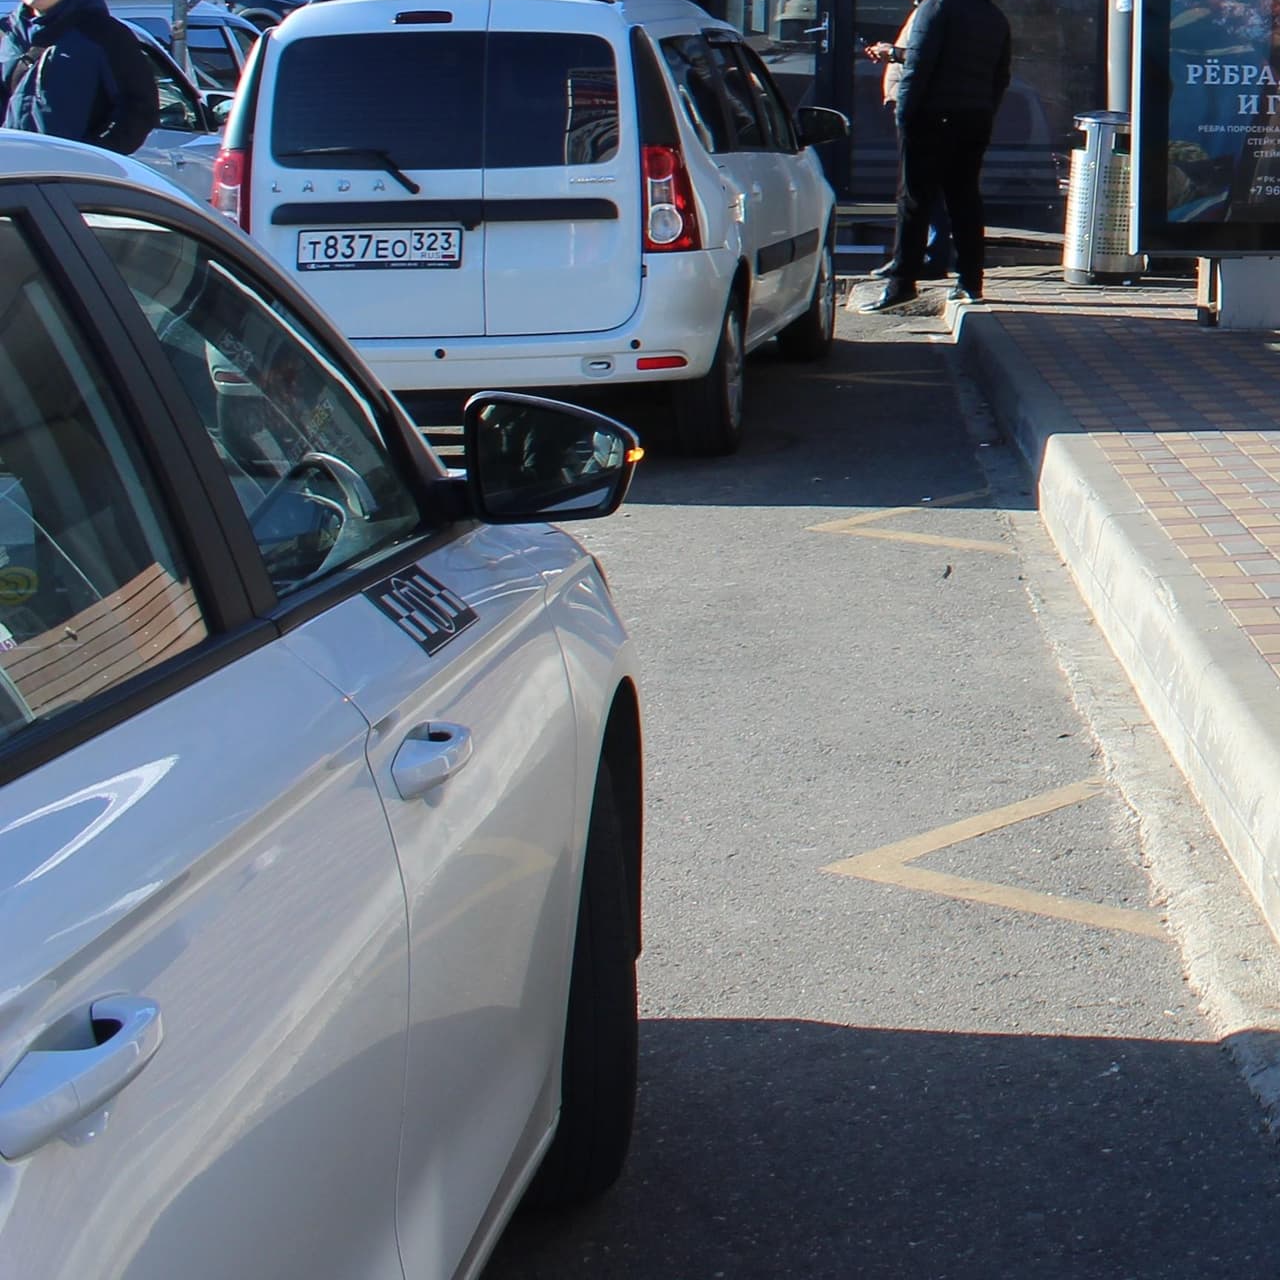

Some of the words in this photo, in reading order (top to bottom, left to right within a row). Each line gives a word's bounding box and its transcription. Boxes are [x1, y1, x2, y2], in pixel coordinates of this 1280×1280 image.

[1237, 94, 1265, 115] И
[271, 178, 386, 193] LADA
[1249, 186, 1263, 195] +7
[413, 231, 453, 251] 323
